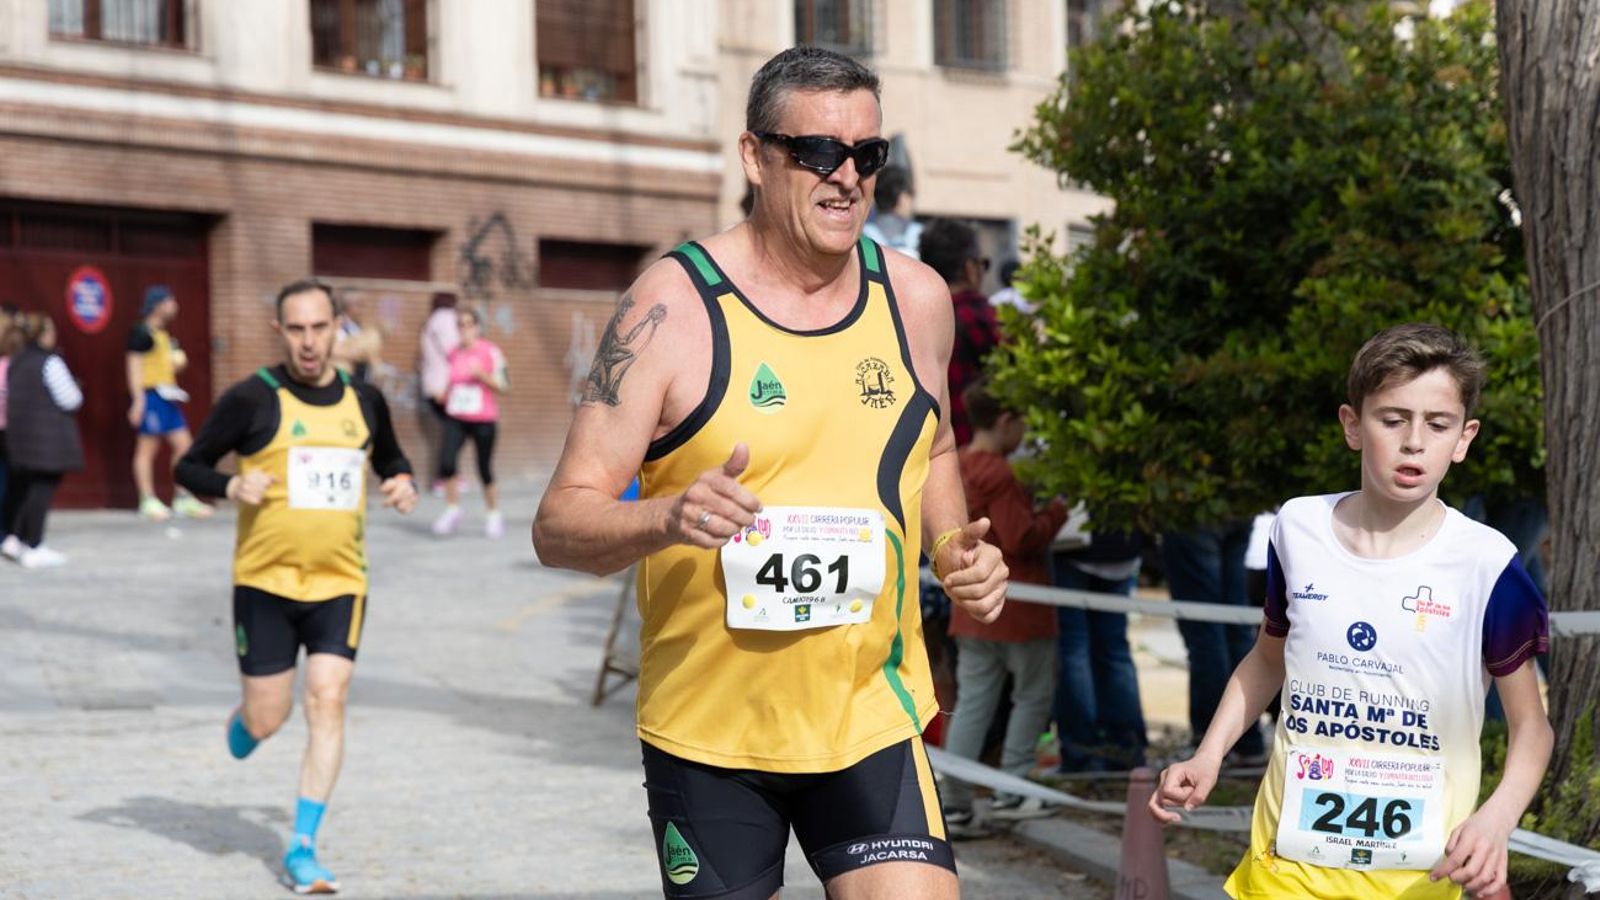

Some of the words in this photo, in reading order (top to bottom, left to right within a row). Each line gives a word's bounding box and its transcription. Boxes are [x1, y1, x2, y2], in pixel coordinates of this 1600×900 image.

[751, 380, 783, 399] Jaén
[755, 552, 850, 594] 461
[1317, 651, 1349, 665] PABLO
[1352, 657, 1404, 674] CARVAJAL
[1290, 680, 1326, 697] CLUB
[1332, 686, 1352, 700] DE
[1359, 690, 1431, 712] RUNNING
[1290, 694, 1359, 719] SANTA
[1367, 705, 1395, 723] Mª
[1402, 710, 1428, 730] DE
[1314, 720, 1440, 751] APÓSTOLES
[1370, 759, 1400, 771] CARRERA
[1400, 761, 1431, 773] POPULAR
[1311, 792, 1413, 840] 246
[871, 839, 934, 851] HYUNDAI
[1325, 835, 1353, 846] ISRAEL
[666, 842, 691, 866] Jaén
[860, 850, 928, 865] JACARSA
